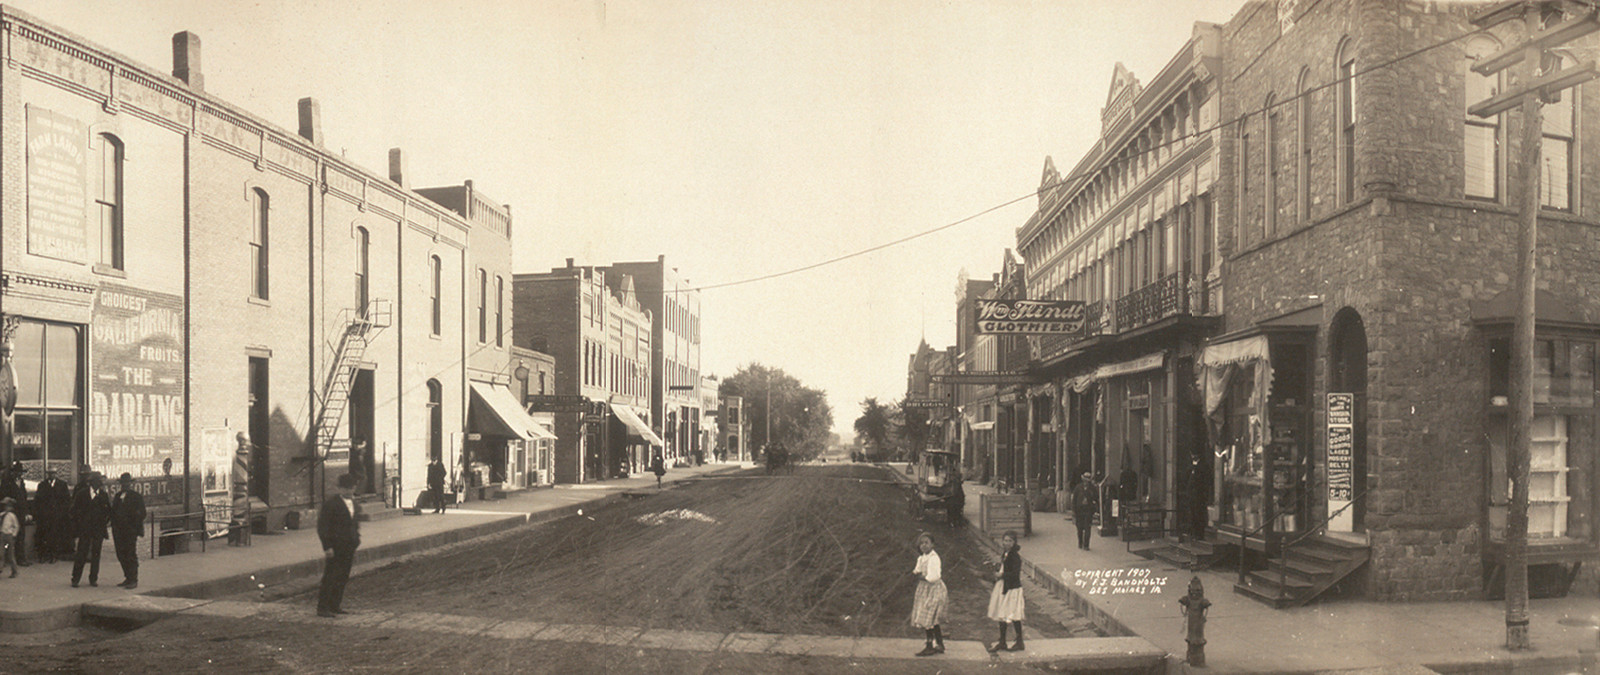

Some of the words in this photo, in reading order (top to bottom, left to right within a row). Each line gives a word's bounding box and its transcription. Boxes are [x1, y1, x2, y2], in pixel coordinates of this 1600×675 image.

[101, 291, 147, 312] CHOICEST
[93, 308, 183, 345] CALIFORNIA
[140, 345, 182, 363] FRUITS.
[122, 366, 153, 386] THE
[92, 391, 183, 437] DARLING
[113, 445, 154, 459] BRAND
[157, 481, 171, 494] IT.
